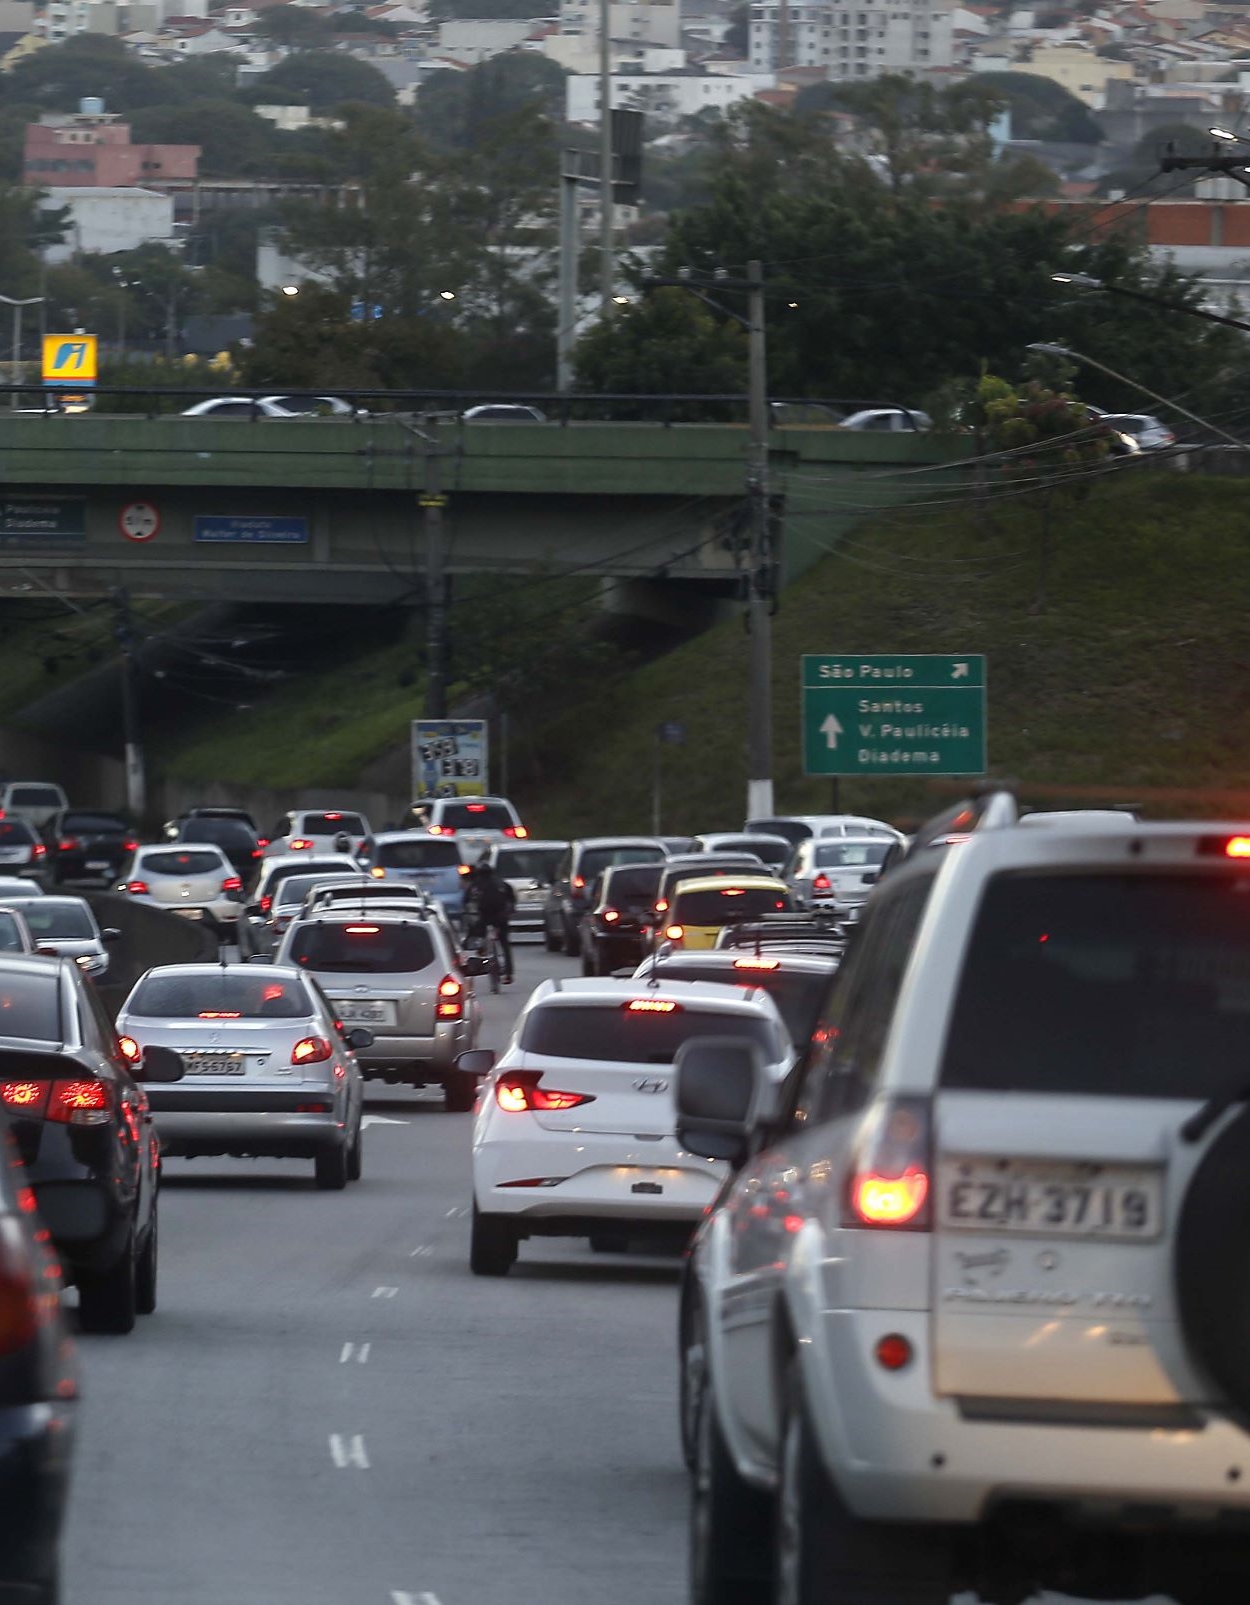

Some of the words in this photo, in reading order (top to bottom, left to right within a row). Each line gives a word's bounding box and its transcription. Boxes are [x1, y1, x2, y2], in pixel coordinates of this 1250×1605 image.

[818, 664, 854, 678] São
[859, 665, 914, 678] Paulo
[858, 700, 924, 713] Santos
[858, 724, 876, 738] V.
[881, 723, 969, 738] Paulicéia
[857, 749, 940, 762] Diadema
[949, 1181, 1148, 1228] EZH-3719
